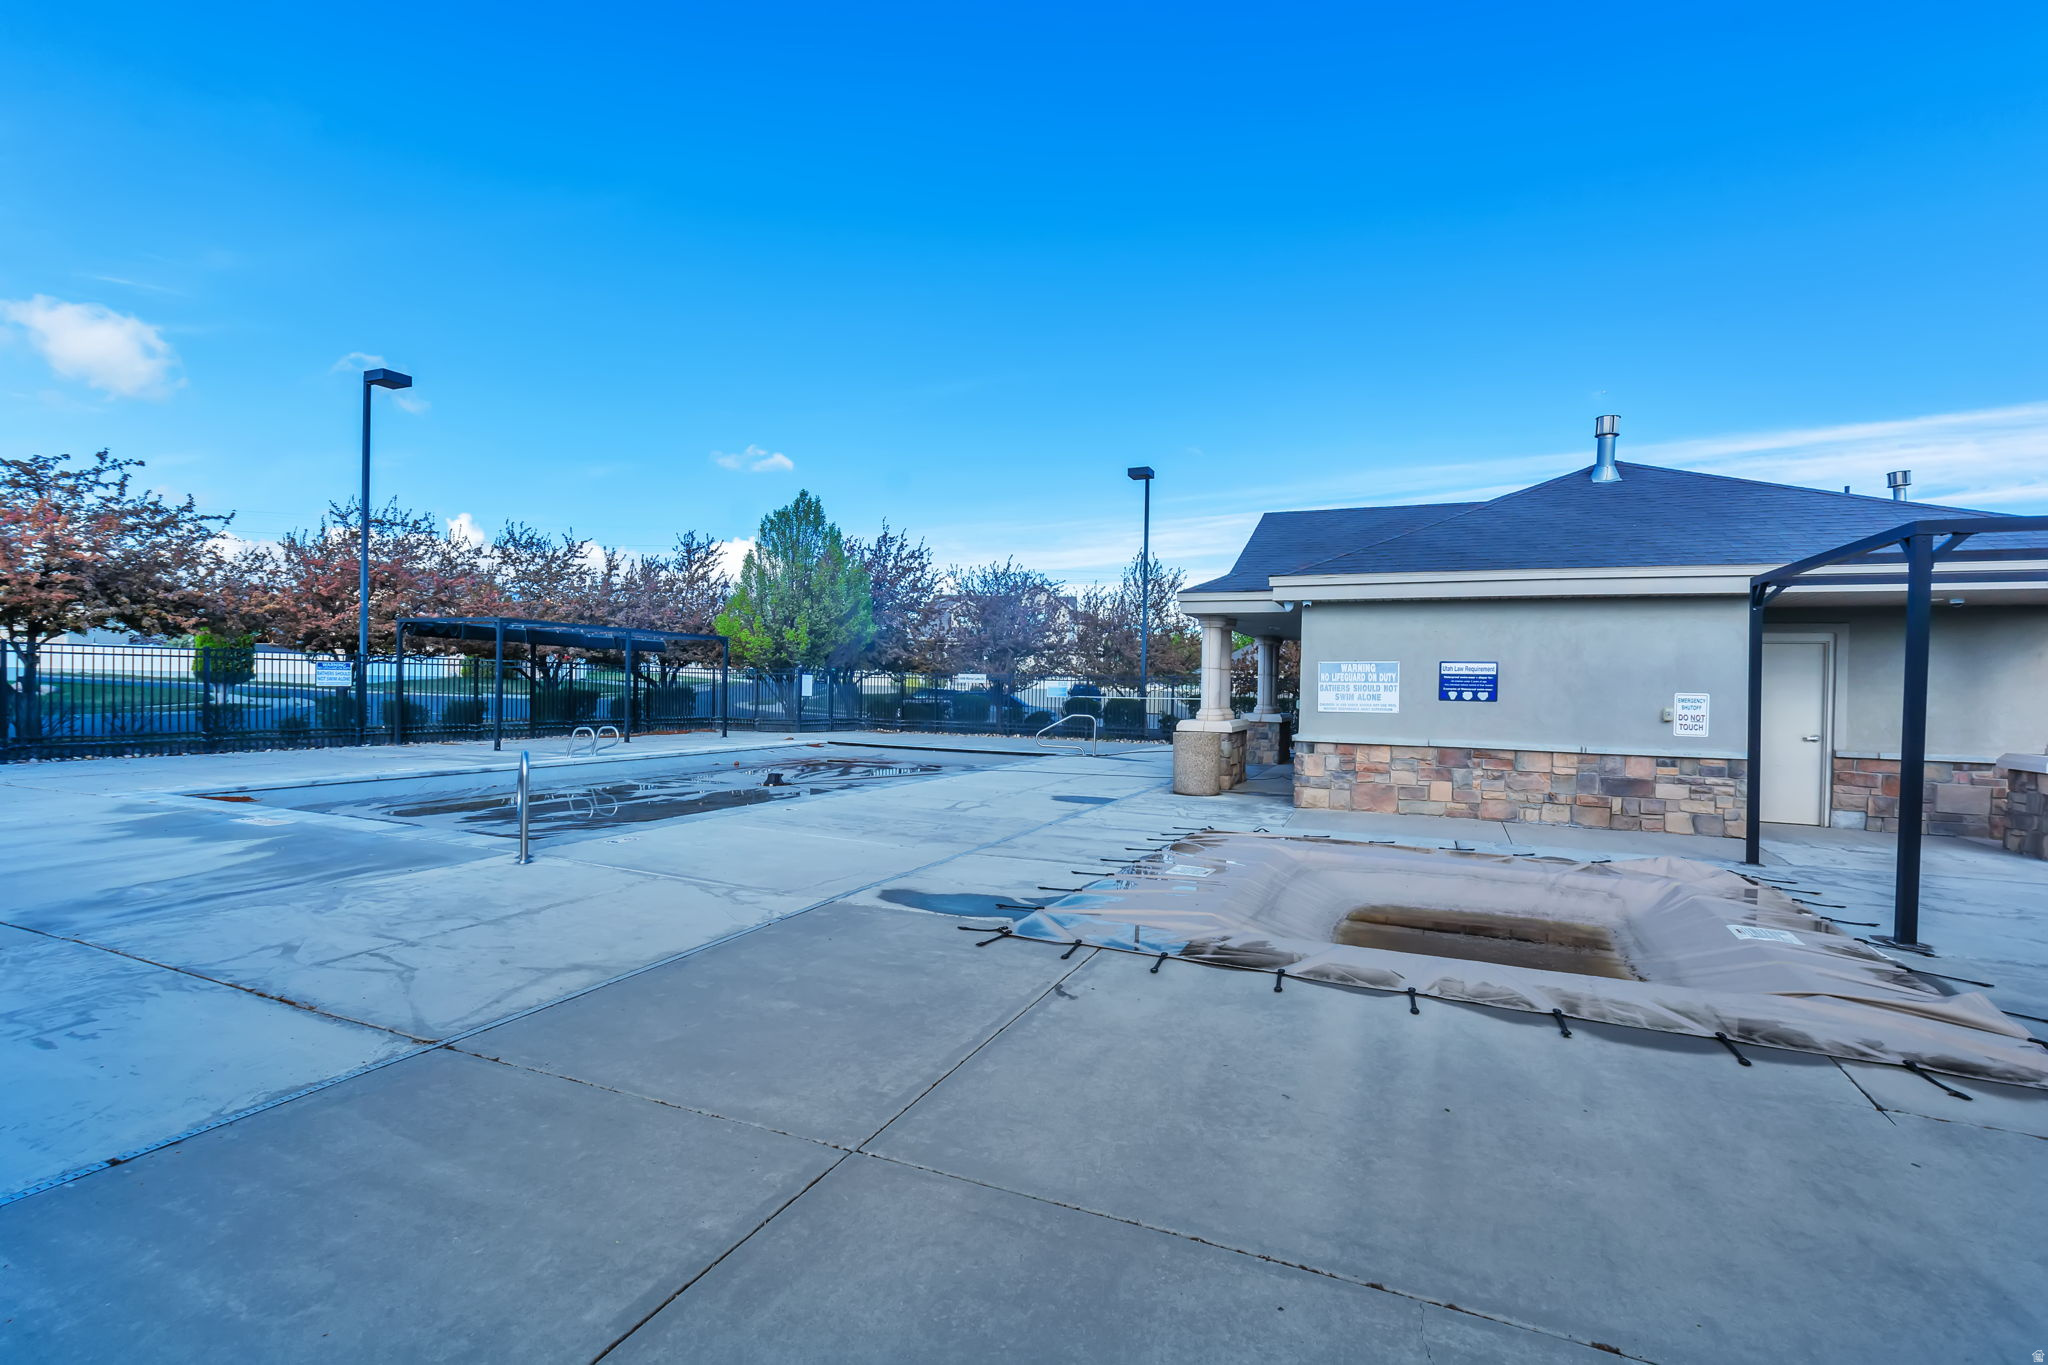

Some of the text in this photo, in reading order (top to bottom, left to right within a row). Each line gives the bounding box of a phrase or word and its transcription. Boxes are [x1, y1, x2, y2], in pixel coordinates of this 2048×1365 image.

[1341, 664, 1376, 672] WARNING
[1321, 673, 1397, 682] NO LIFEGUARD ON DUTY
